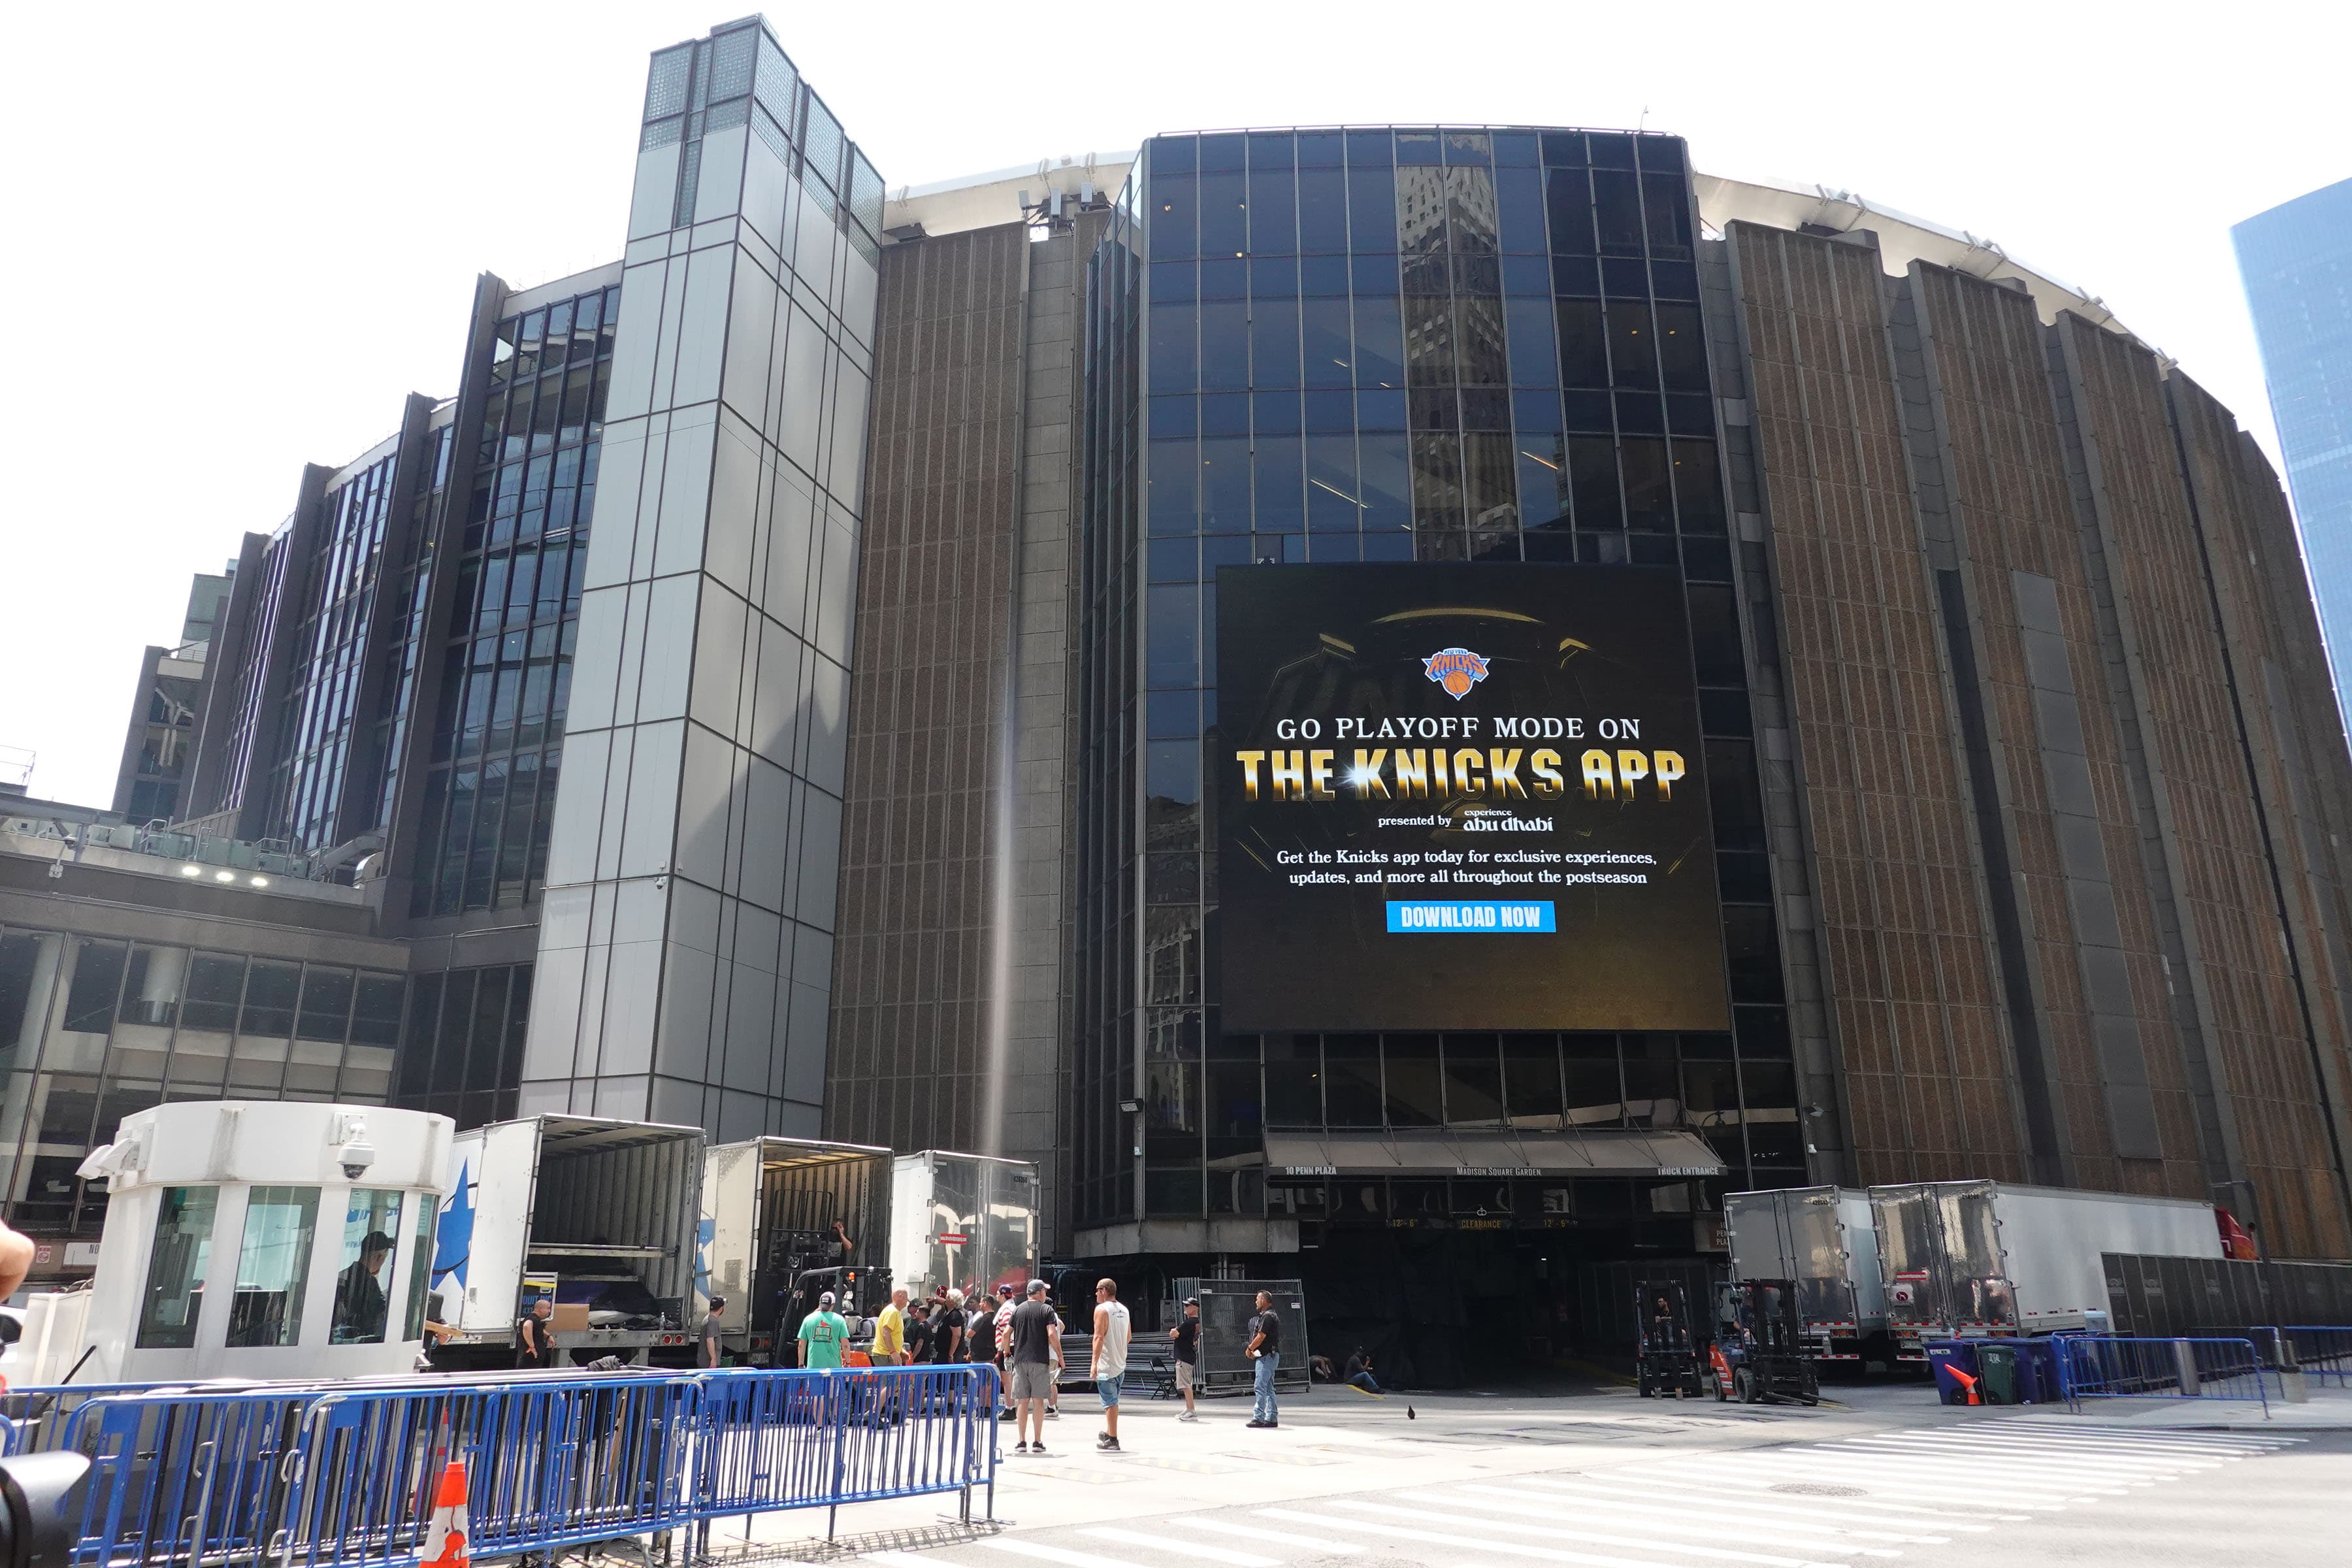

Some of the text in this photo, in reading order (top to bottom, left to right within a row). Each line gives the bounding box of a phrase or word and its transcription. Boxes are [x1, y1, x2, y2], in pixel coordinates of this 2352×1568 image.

[1428, 654, 1486, 675] KNICKS
[1277, 717, 1640, 739] GO PLAYOFF MODE ON
[1237, 748, 1686, 802] THE KNICKS APP
[1378, 815, 1452, 828] presented by
[1464, 809, 1512, 818] experience
[1463, 816, 1553, 832] abu dhabi
[1277, 850, 1657, 866] Get the Knicks app today for exclusive experiences,
[1289, 870, 1647, 886] updates, and more all throughout the postseason
[1401, 906, 1540, 927] DOWNLOAD NOW
[1286, 1166, 1337, 1175] 10 PENN PLAZA
[1456, 1167, 1541, 1176] MADISON SQUARE GARDEN
[1658, 1167, 1719, 1175] TRUCK ENTRANCE
[1461, 1219, 1501, 1228] CLEARANCE
